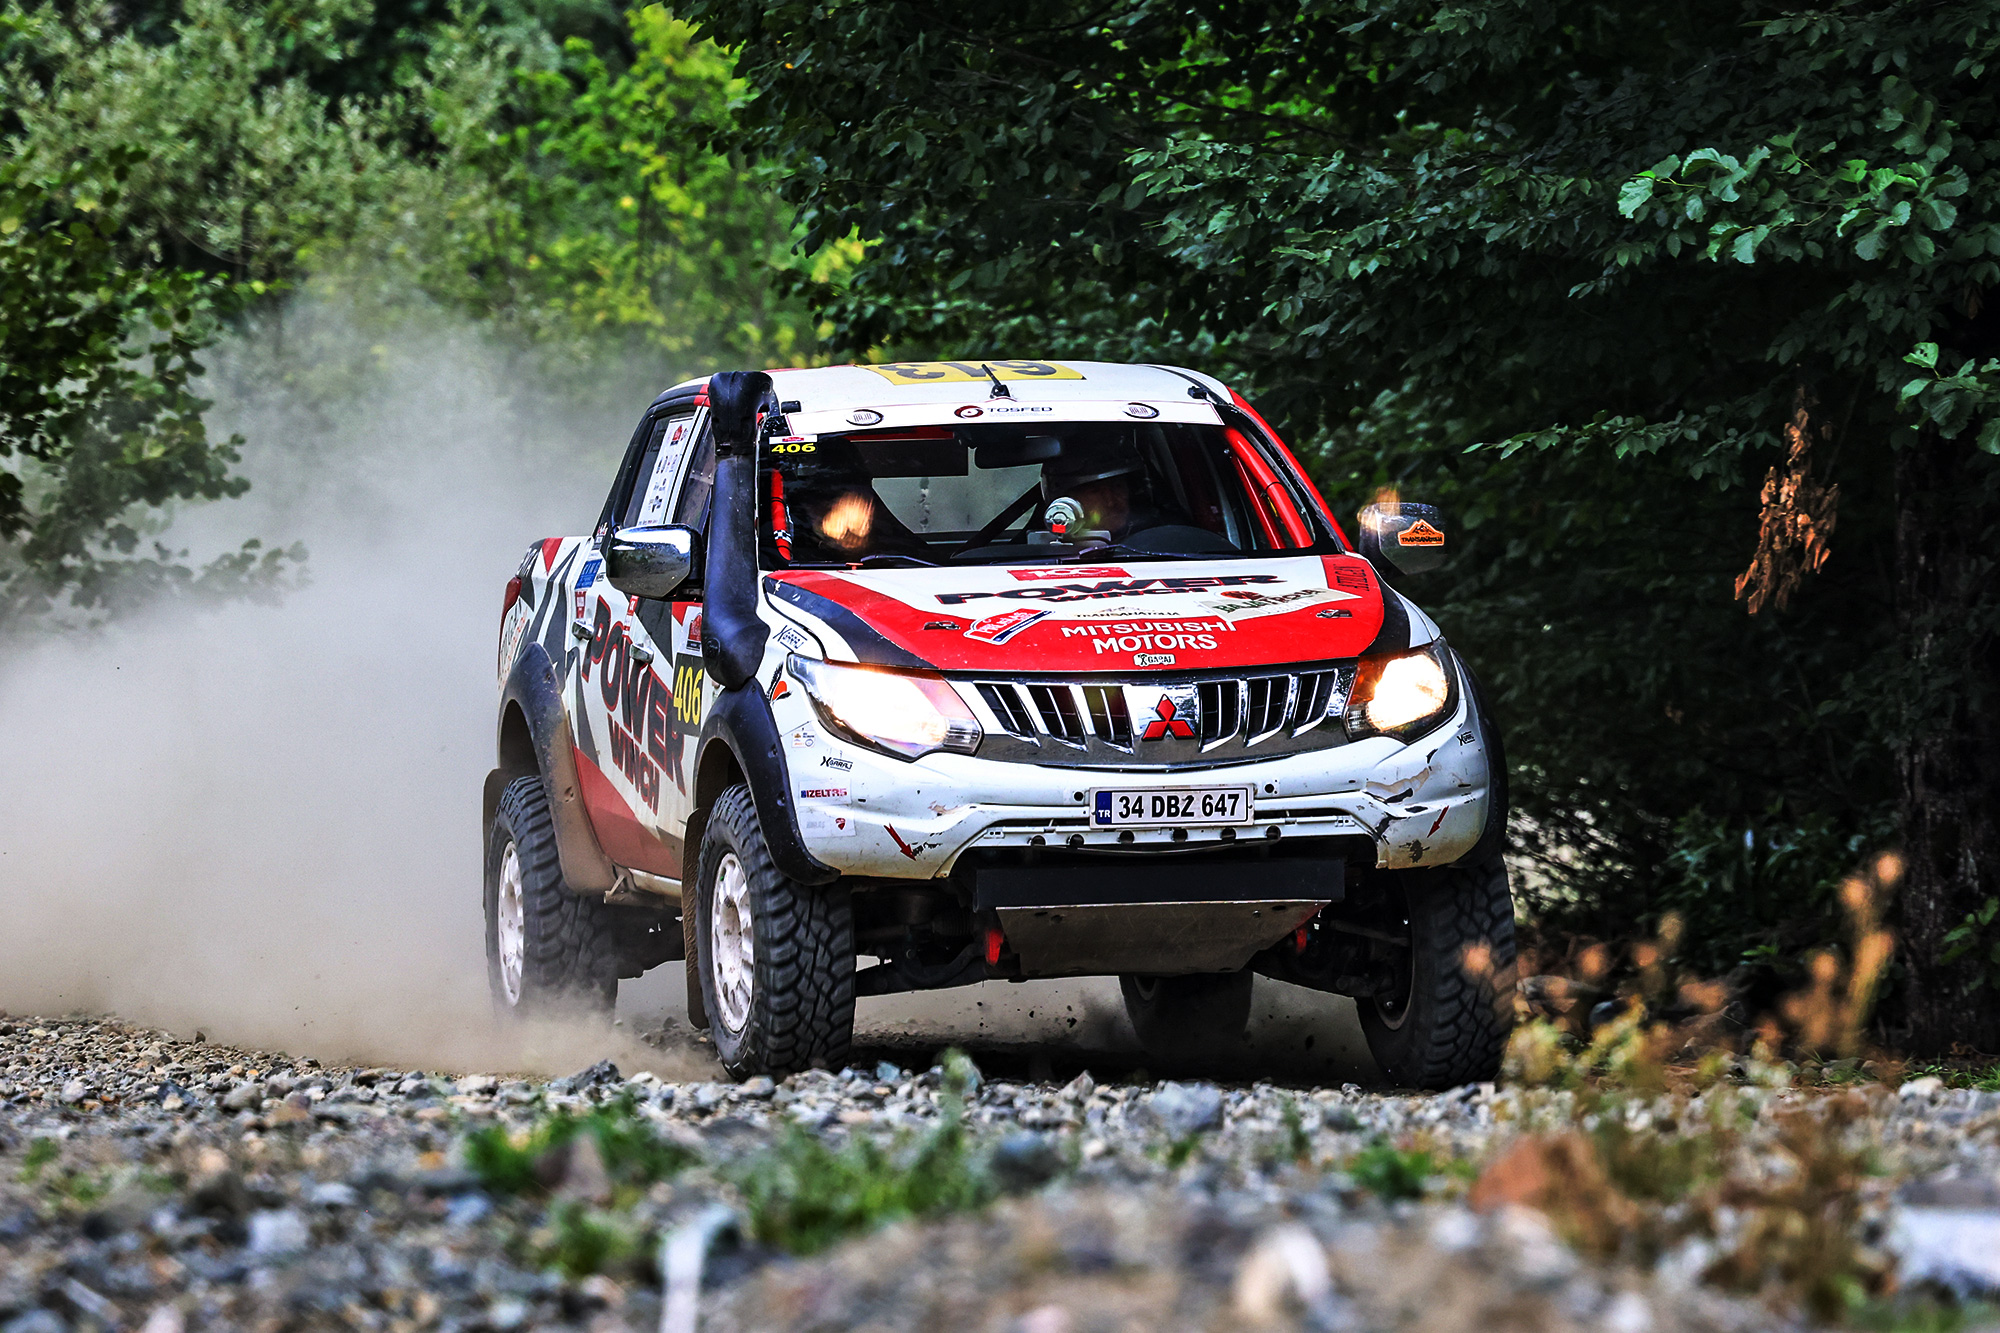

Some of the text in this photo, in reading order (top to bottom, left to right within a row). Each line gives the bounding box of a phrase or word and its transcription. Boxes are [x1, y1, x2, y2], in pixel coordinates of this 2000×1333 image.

[771, 442, 816, 454] 406
[934, 574, 1288, 605] POWER
[1060, 620, 1237, 638] MITSUBISHI
[1092, 634, 1218, 655] MOTORS
[582, 594, 687, 797] POWER
[673, 665, 702, 726] 406
[607, 712, 661, 817] WINCH
[1098, 793, 1240, 819] TR 34 DBZ 647
